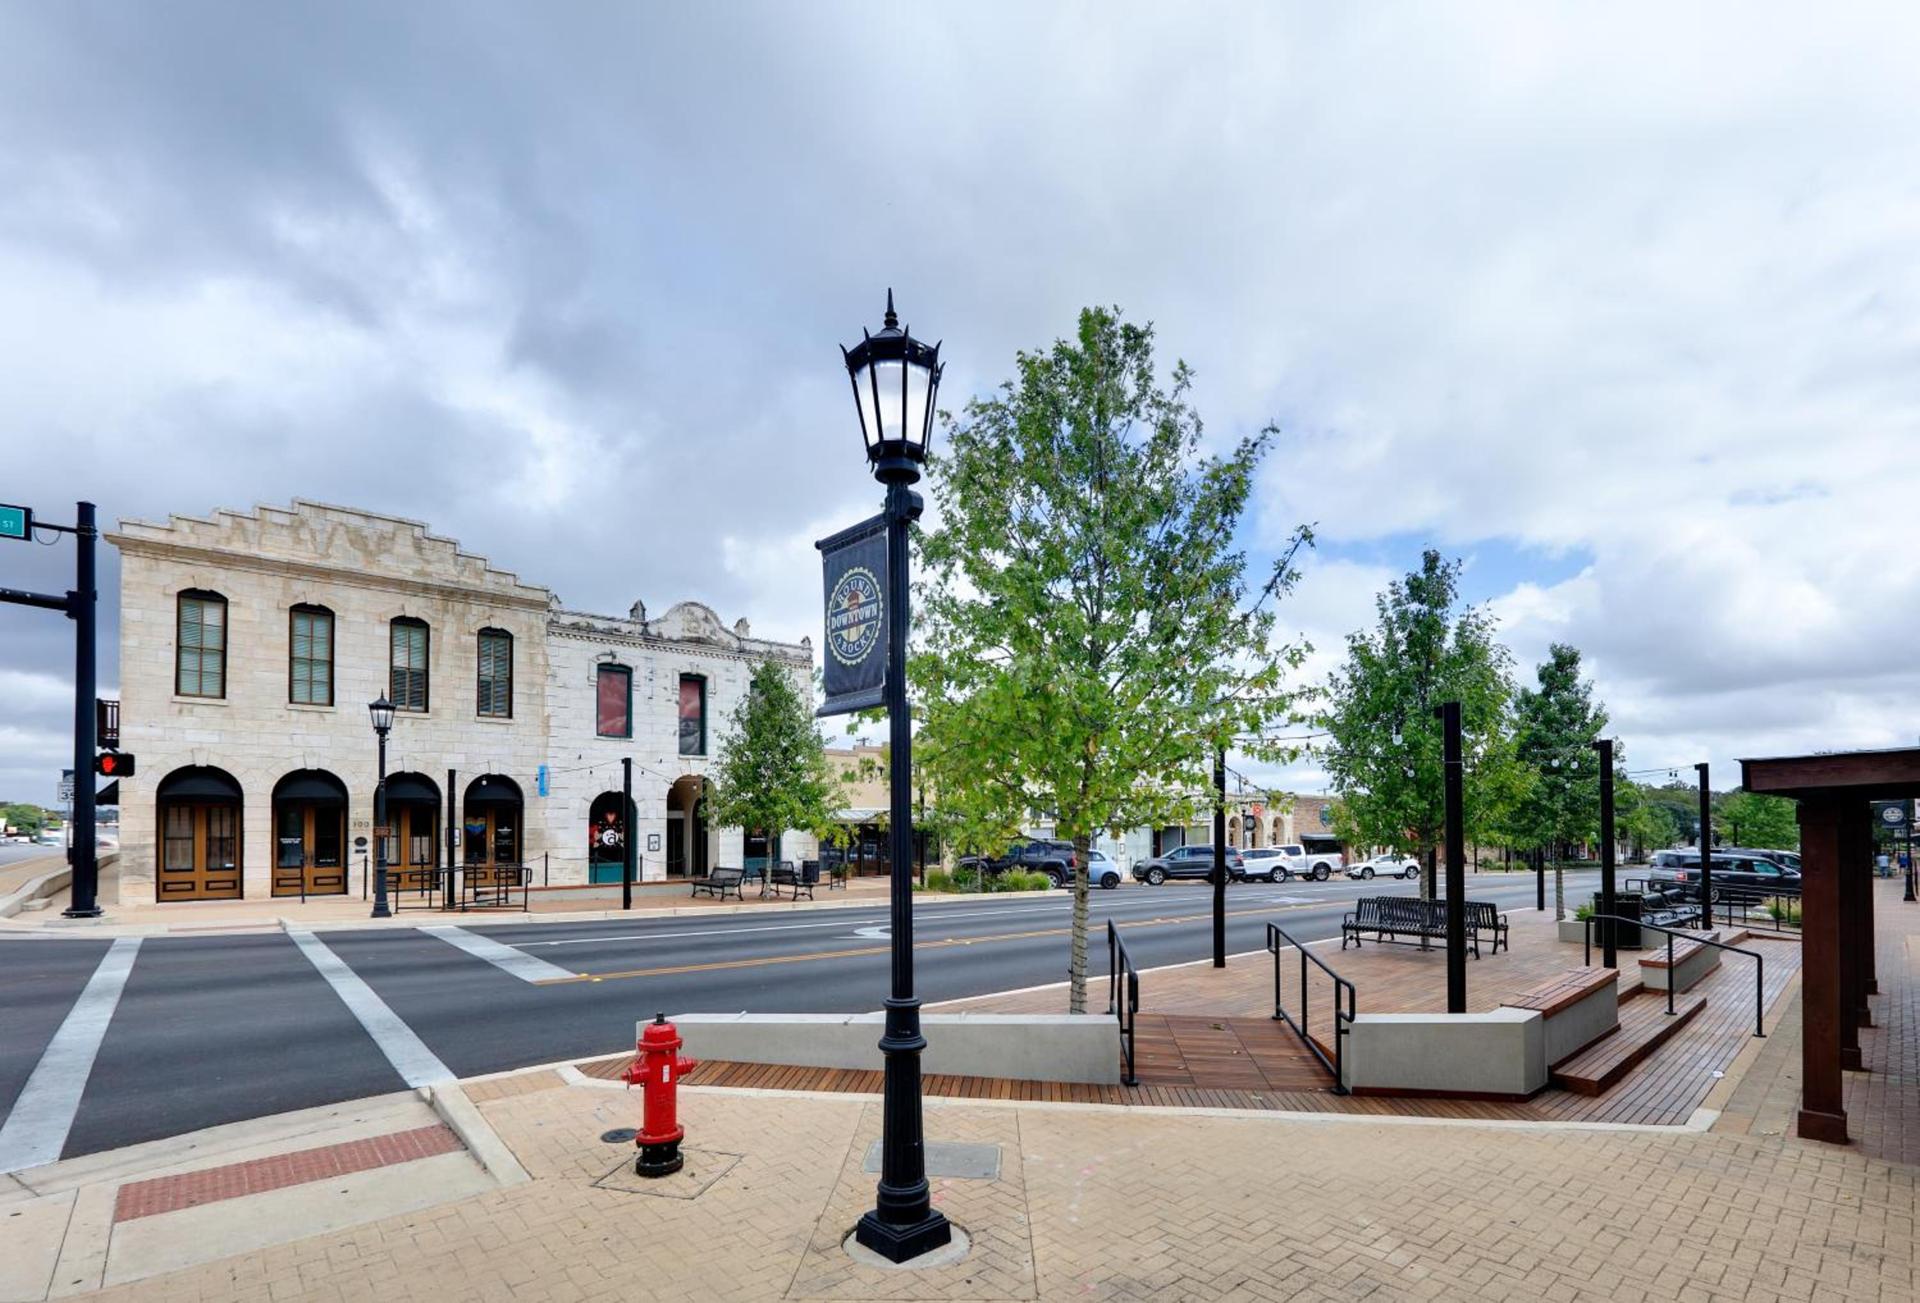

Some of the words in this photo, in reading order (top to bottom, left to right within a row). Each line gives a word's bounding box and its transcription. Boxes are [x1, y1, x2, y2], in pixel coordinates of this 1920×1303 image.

[838, 580, 871, 604] ROUND
[831, 603, 878, 629] DOWNTOWN
[841, 636, 867, 653] ROCK
